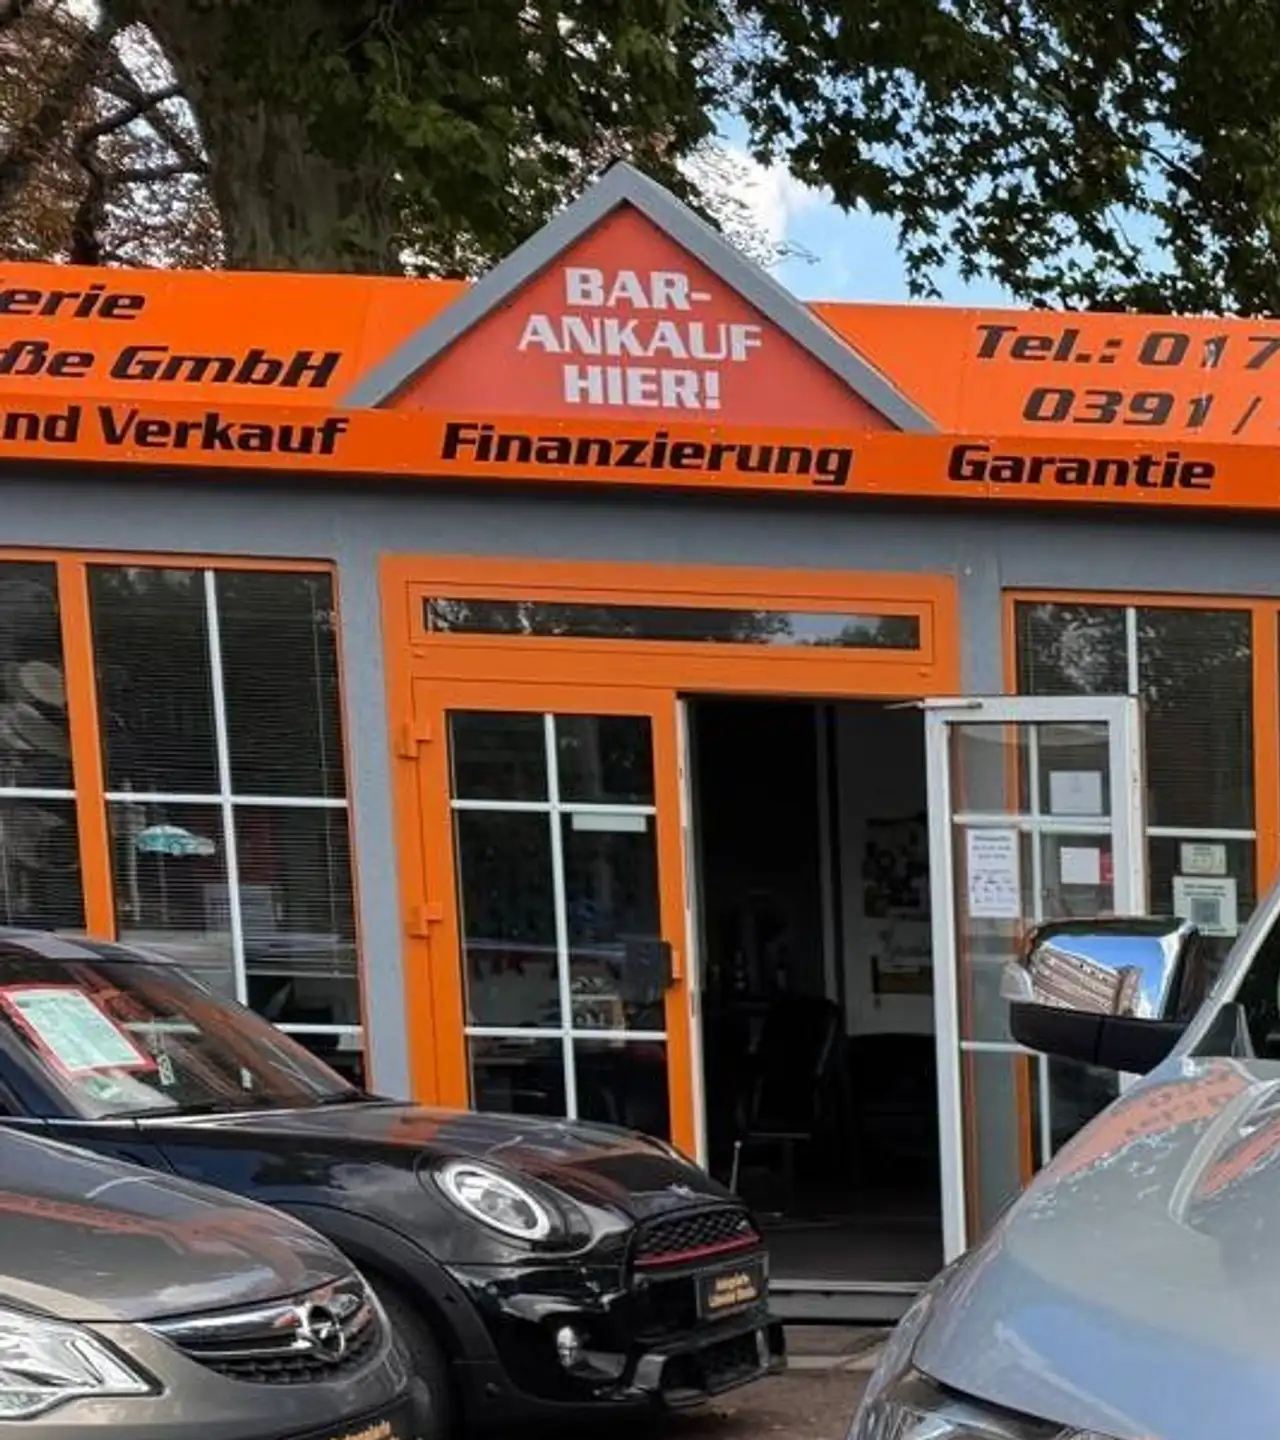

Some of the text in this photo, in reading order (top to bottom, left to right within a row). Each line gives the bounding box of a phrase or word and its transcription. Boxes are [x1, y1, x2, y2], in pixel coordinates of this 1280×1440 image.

[0, 284, 146, 320] erie
[564, 266, 712, 311] BAR-
[517, 314, 764, 363] ANKAUF
[976, 324, 1123, 364] Tel.:
[110, 345, 342, 388] GmbH
[563, 364, 722, 411] HIER!
[3, 405, 350, 456] nd Verkauf
[1022, 387, 1214, 429] 0391
[1231, 396, 1262, 436] /
[441, 421, 853, 487] Finanzierung
[947, 443, 1216, 490] Garantie
